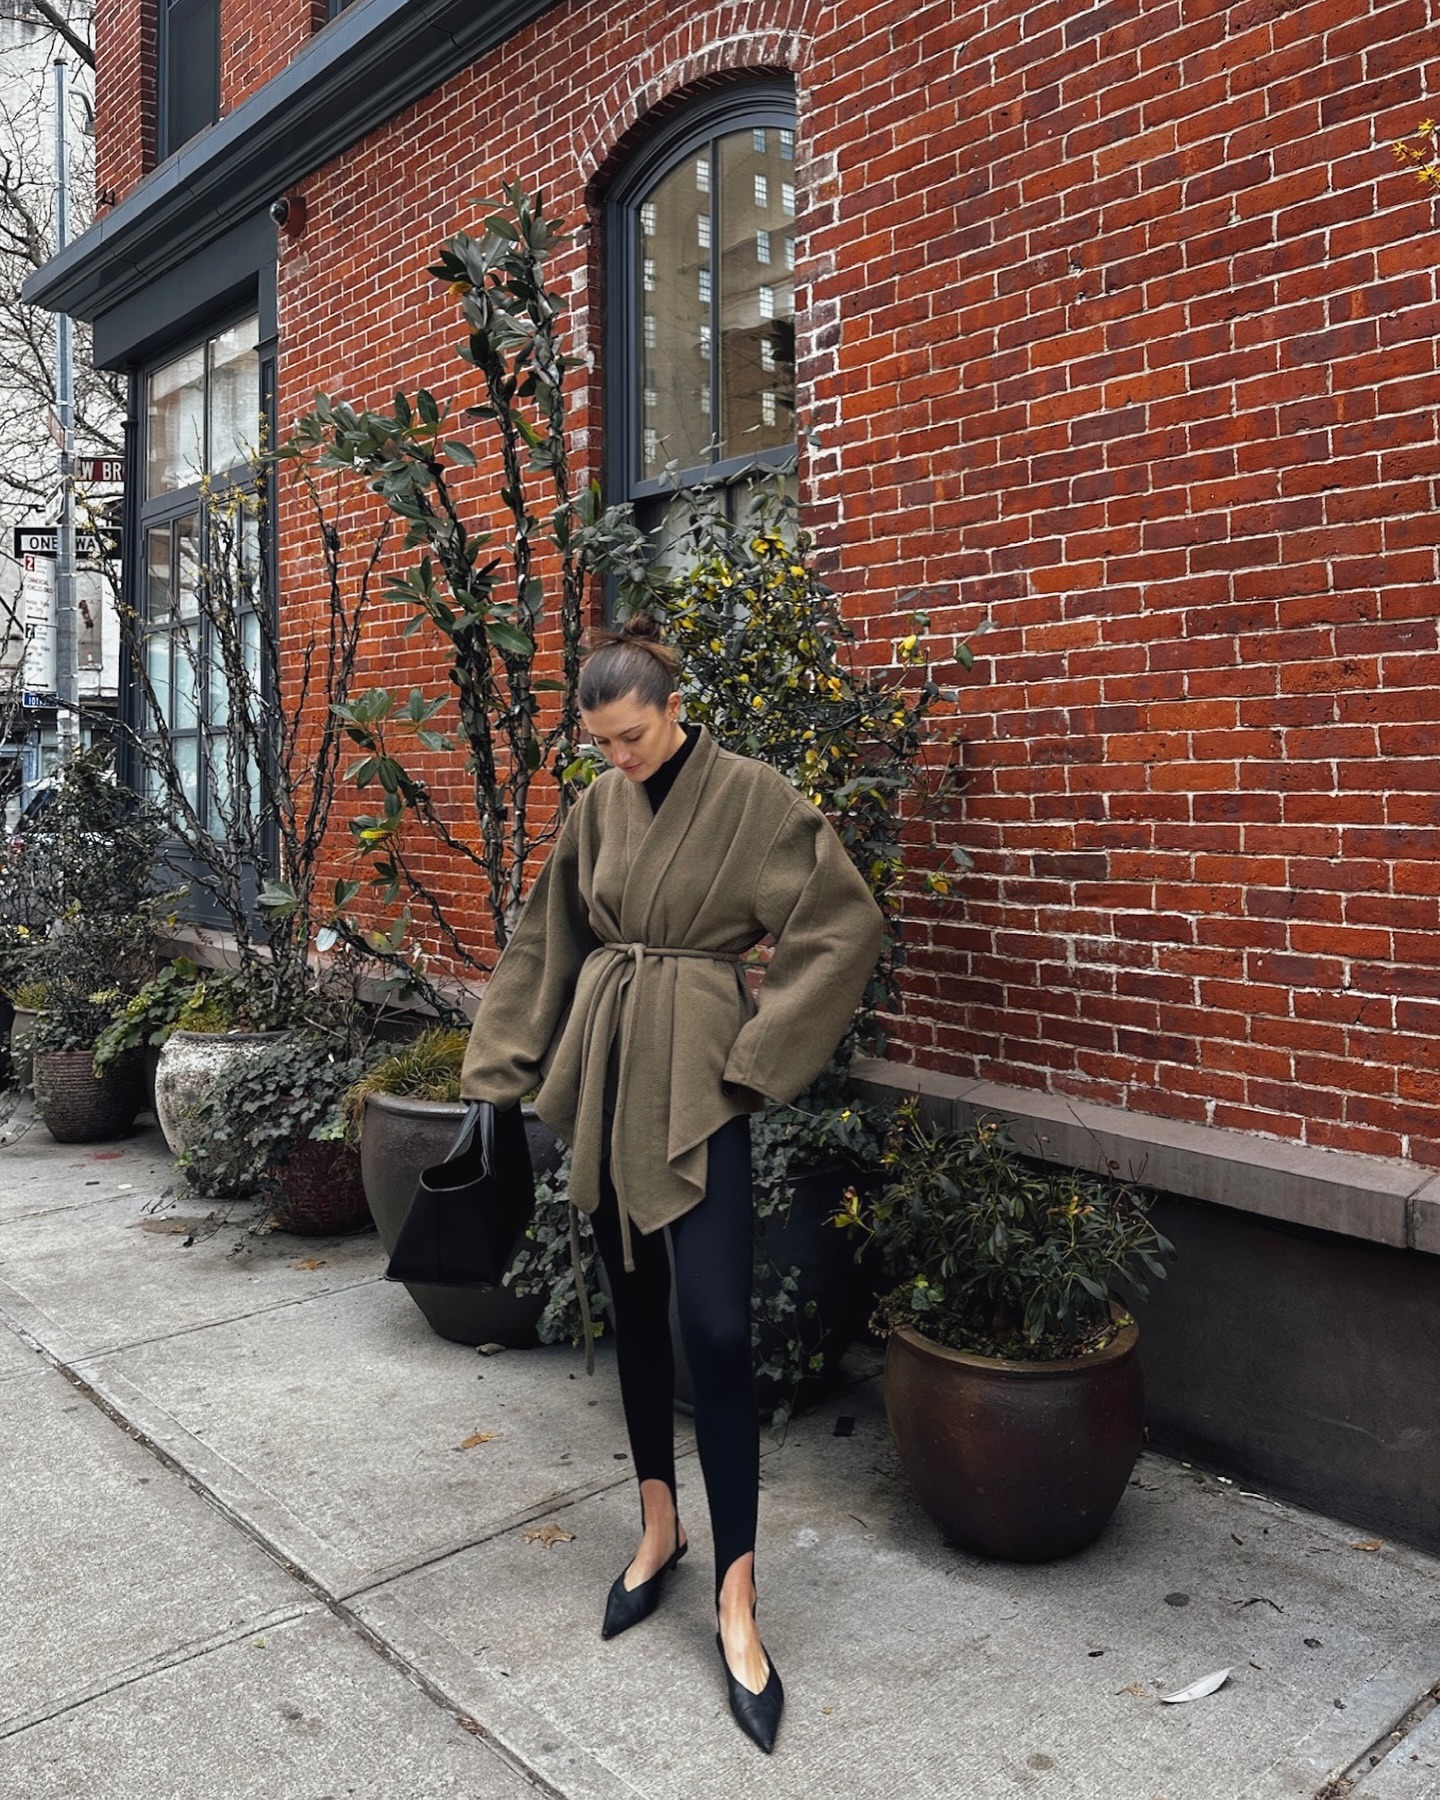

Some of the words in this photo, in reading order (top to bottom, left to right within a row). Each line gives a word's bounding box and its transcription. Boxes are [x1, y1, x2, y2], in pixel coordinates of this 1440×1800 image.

[81, 461, 95, 480] W
[102, 461, 124, 481] BR
[29, 536, 57, 550] ONE
[26, 556, 34, 571] 2
